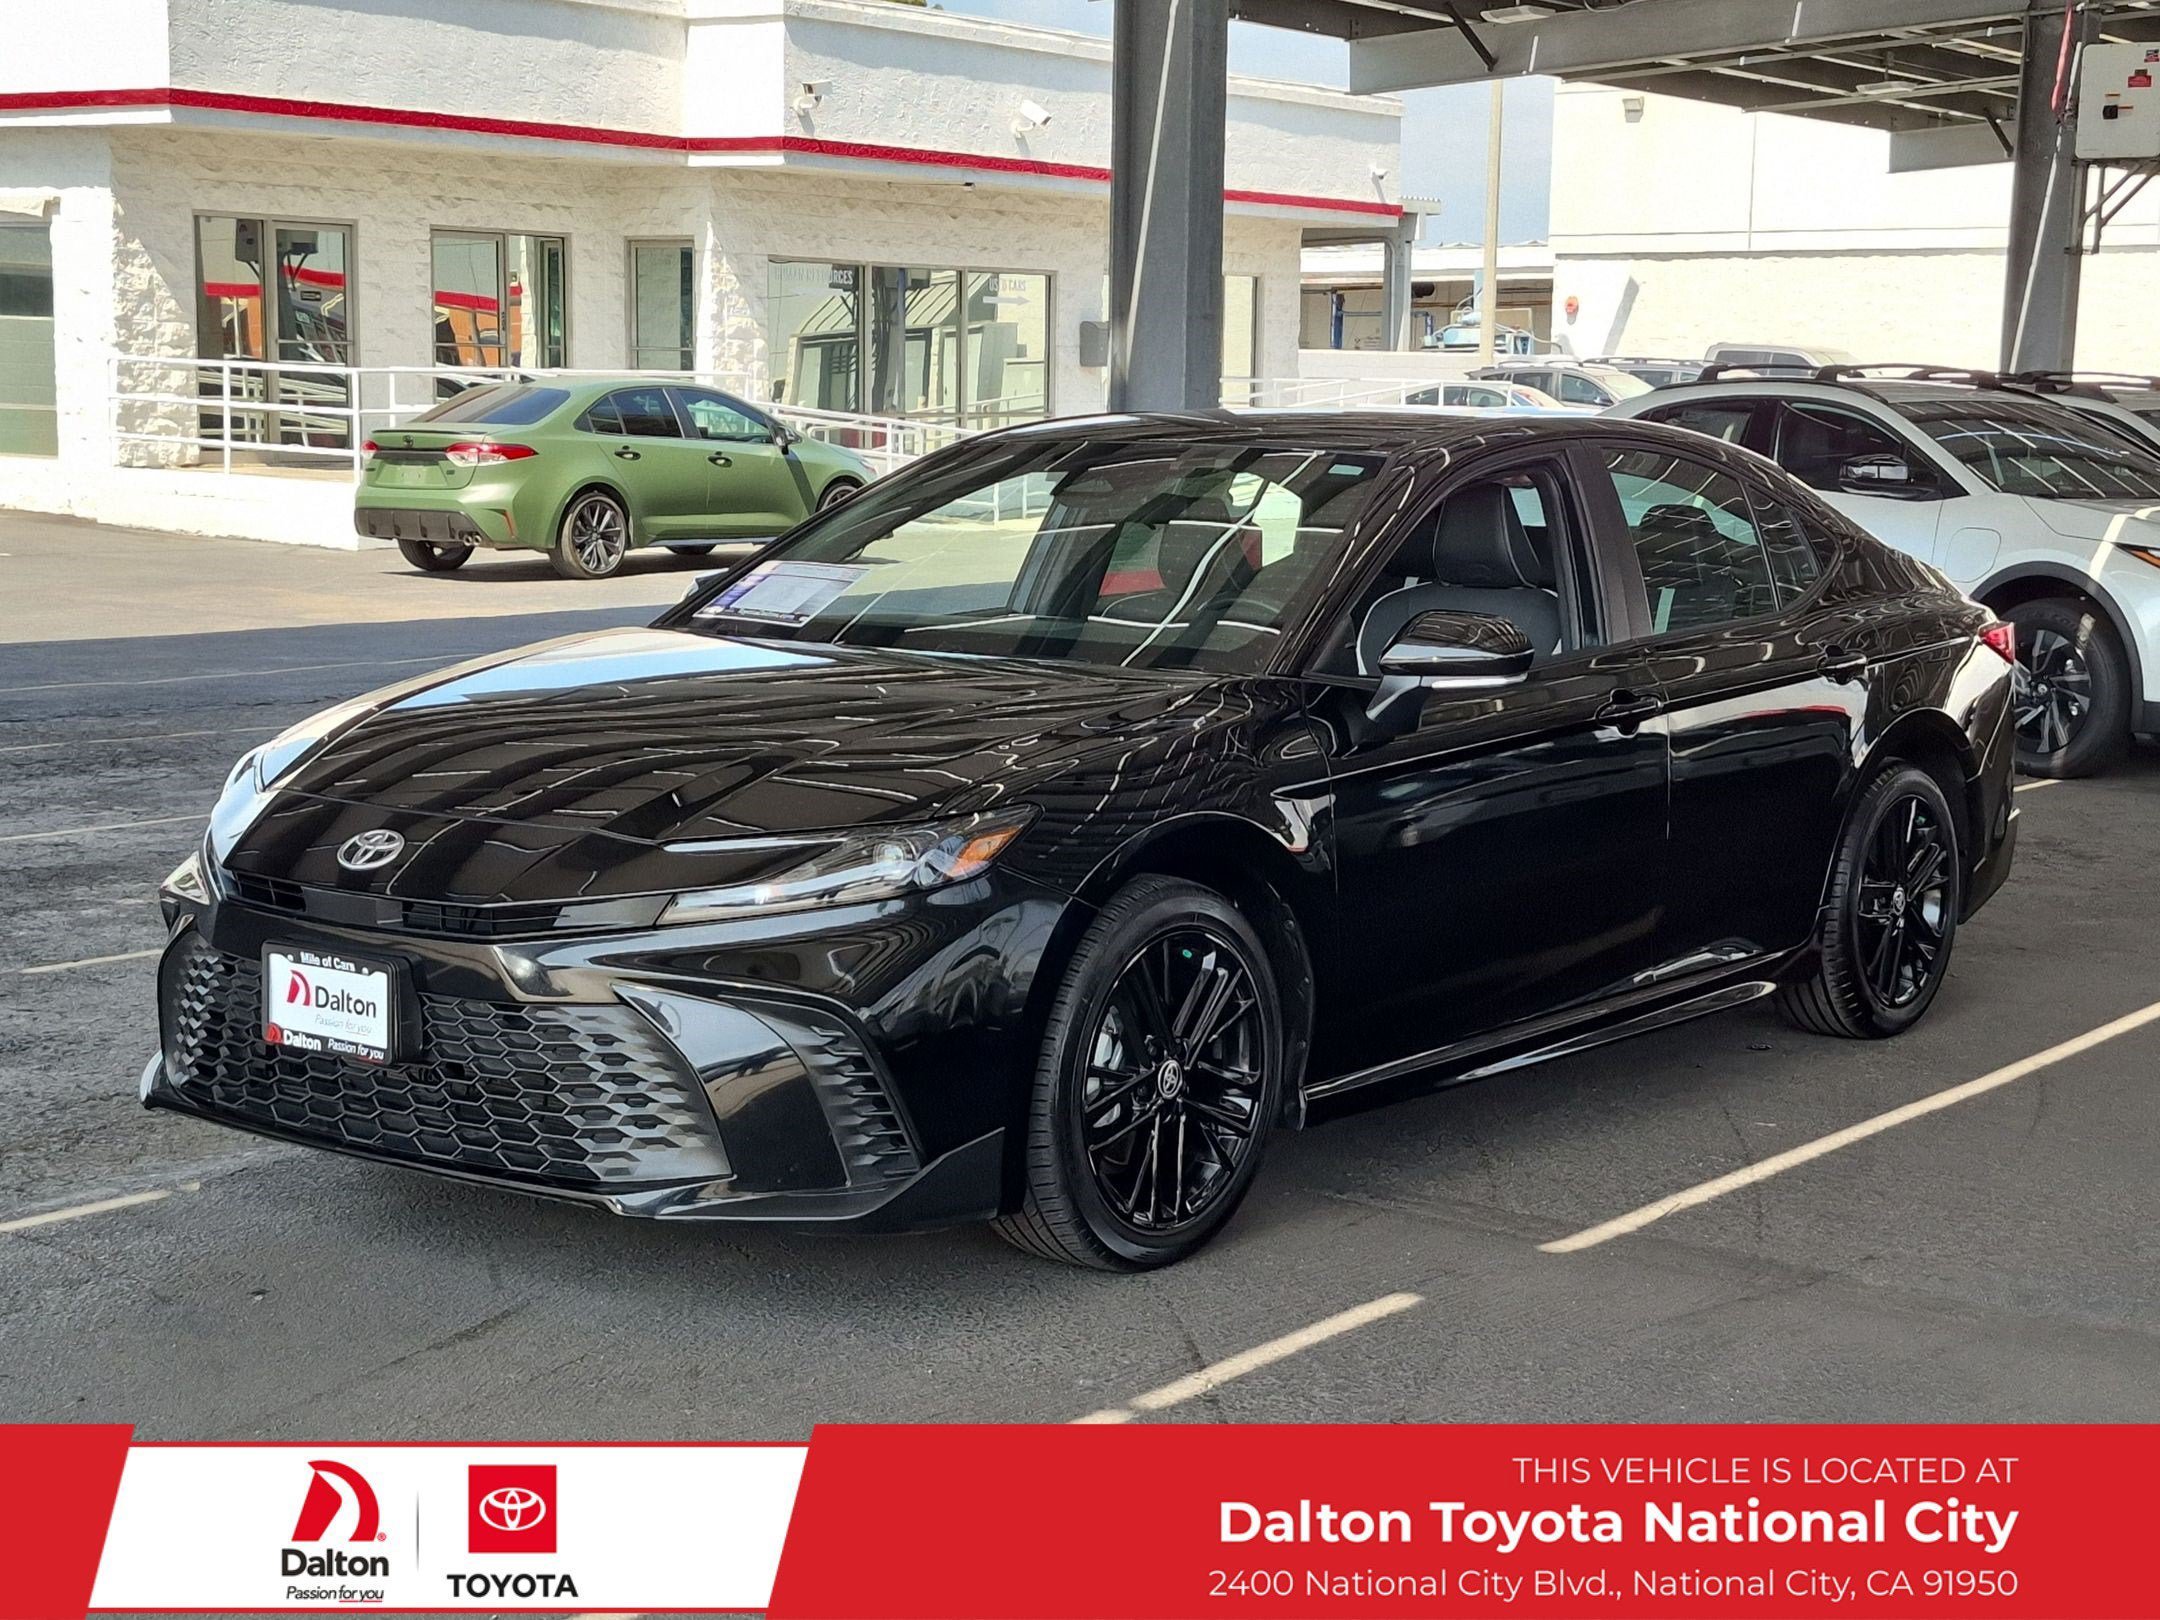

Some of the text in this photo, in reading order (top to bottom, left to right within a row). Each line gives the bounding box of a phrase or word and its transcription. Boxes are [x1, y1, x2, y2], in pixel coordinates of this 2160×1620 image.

[315, 985, 377, 1018] Dalton
[283, 1029, 322, 1051] Dalton
[327, 1038, 356, 1054] Passion
[369, 1048, 384, 1060] you
